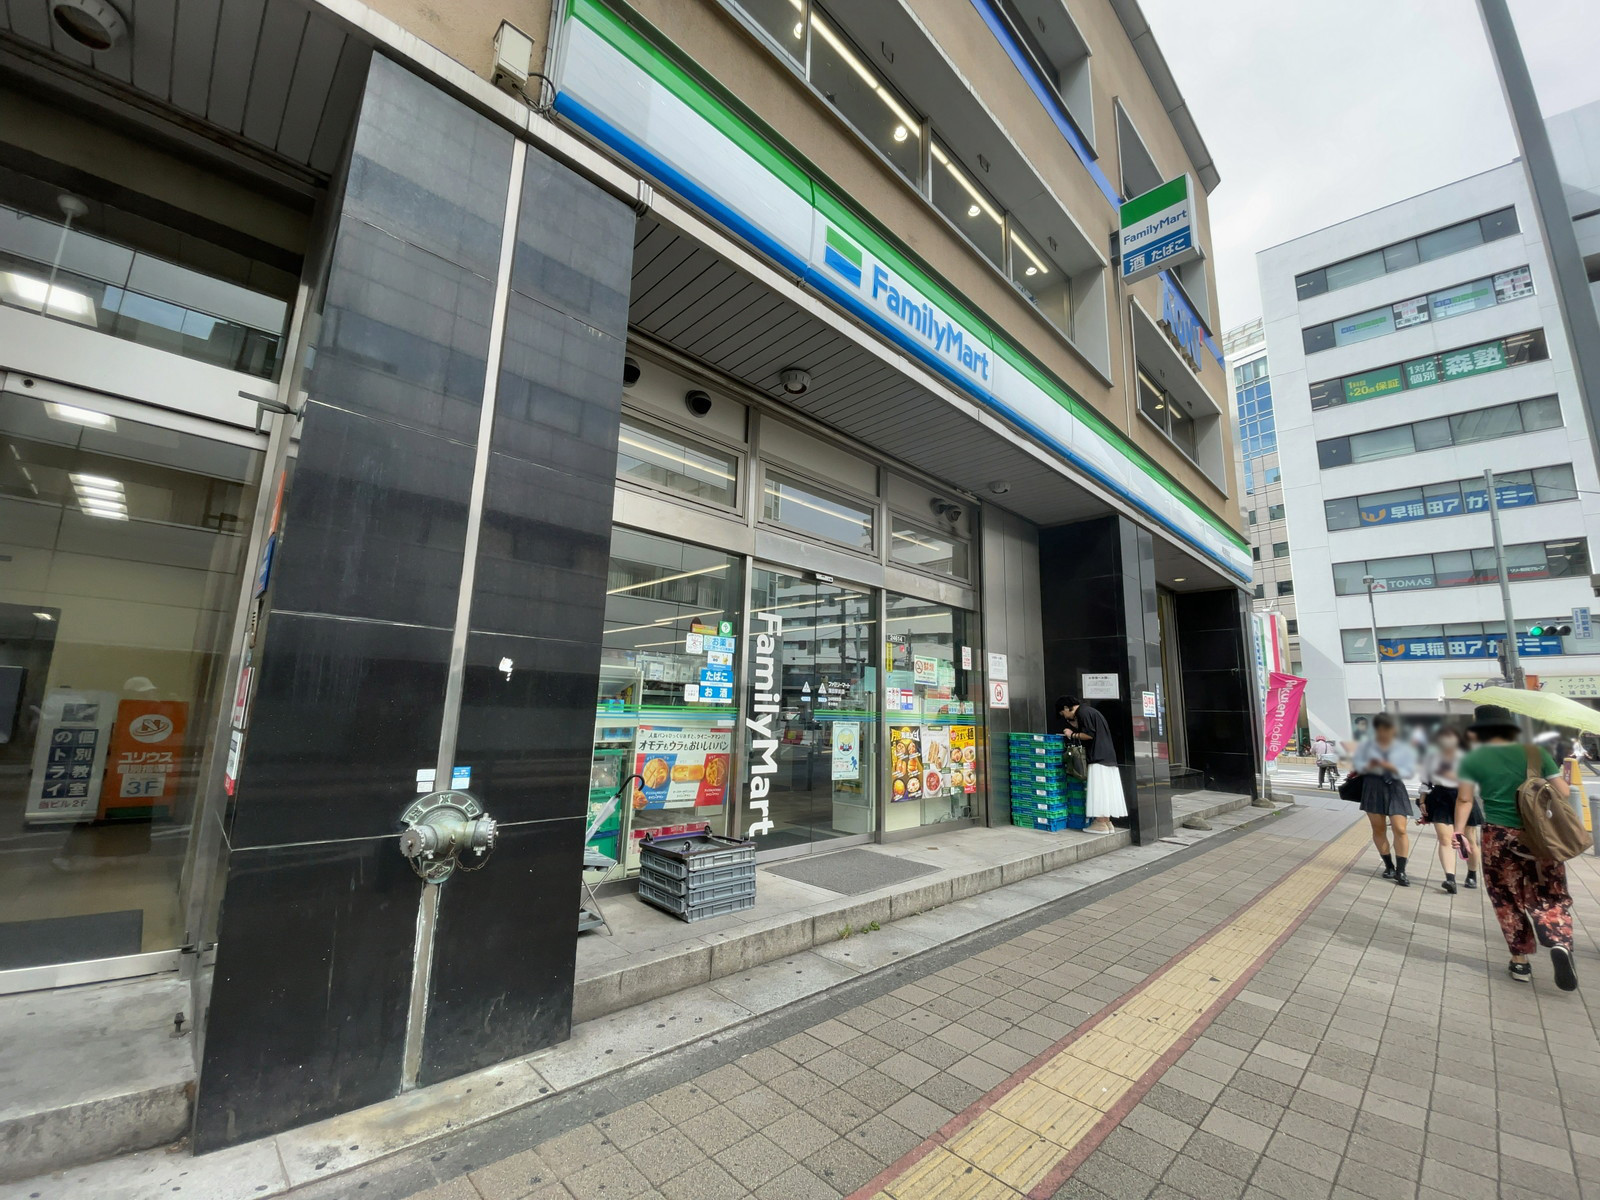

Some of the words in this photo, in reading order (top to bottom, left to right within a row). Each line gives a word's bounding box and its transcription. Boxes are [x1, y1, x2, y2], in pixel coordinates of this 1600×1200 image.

[1123, 209, 1187, 246] FamilyMart
[1129, 253, 1146, 272] 酒
[1150, 238, 1186, 262] たばこ
[872, 263, 989, 381] FamilyMart
[1407, 361, 1435, 375] 1対2
[1445, 347, 1503, 376] 森塾
[1409, 371, 1436, 385] 個別
[1388, 577, 1432, 588] TOMAS
[1409, 637, 1558, 656] 早稲田アカミー
[705, 670, 728, 682] たばこ
[704, 687, 728, 698] お酒
[745, 612, 783, 837] FamilyMart
[638, 740, 729, 751] オモテもウラもおいしいパン
[46, 731, 72, 796] のトライ
[68, 730, 96, 796] 個別教室
[118, 752, 174, 763] ユリウス
[126, 781, 160, 795] 3F
